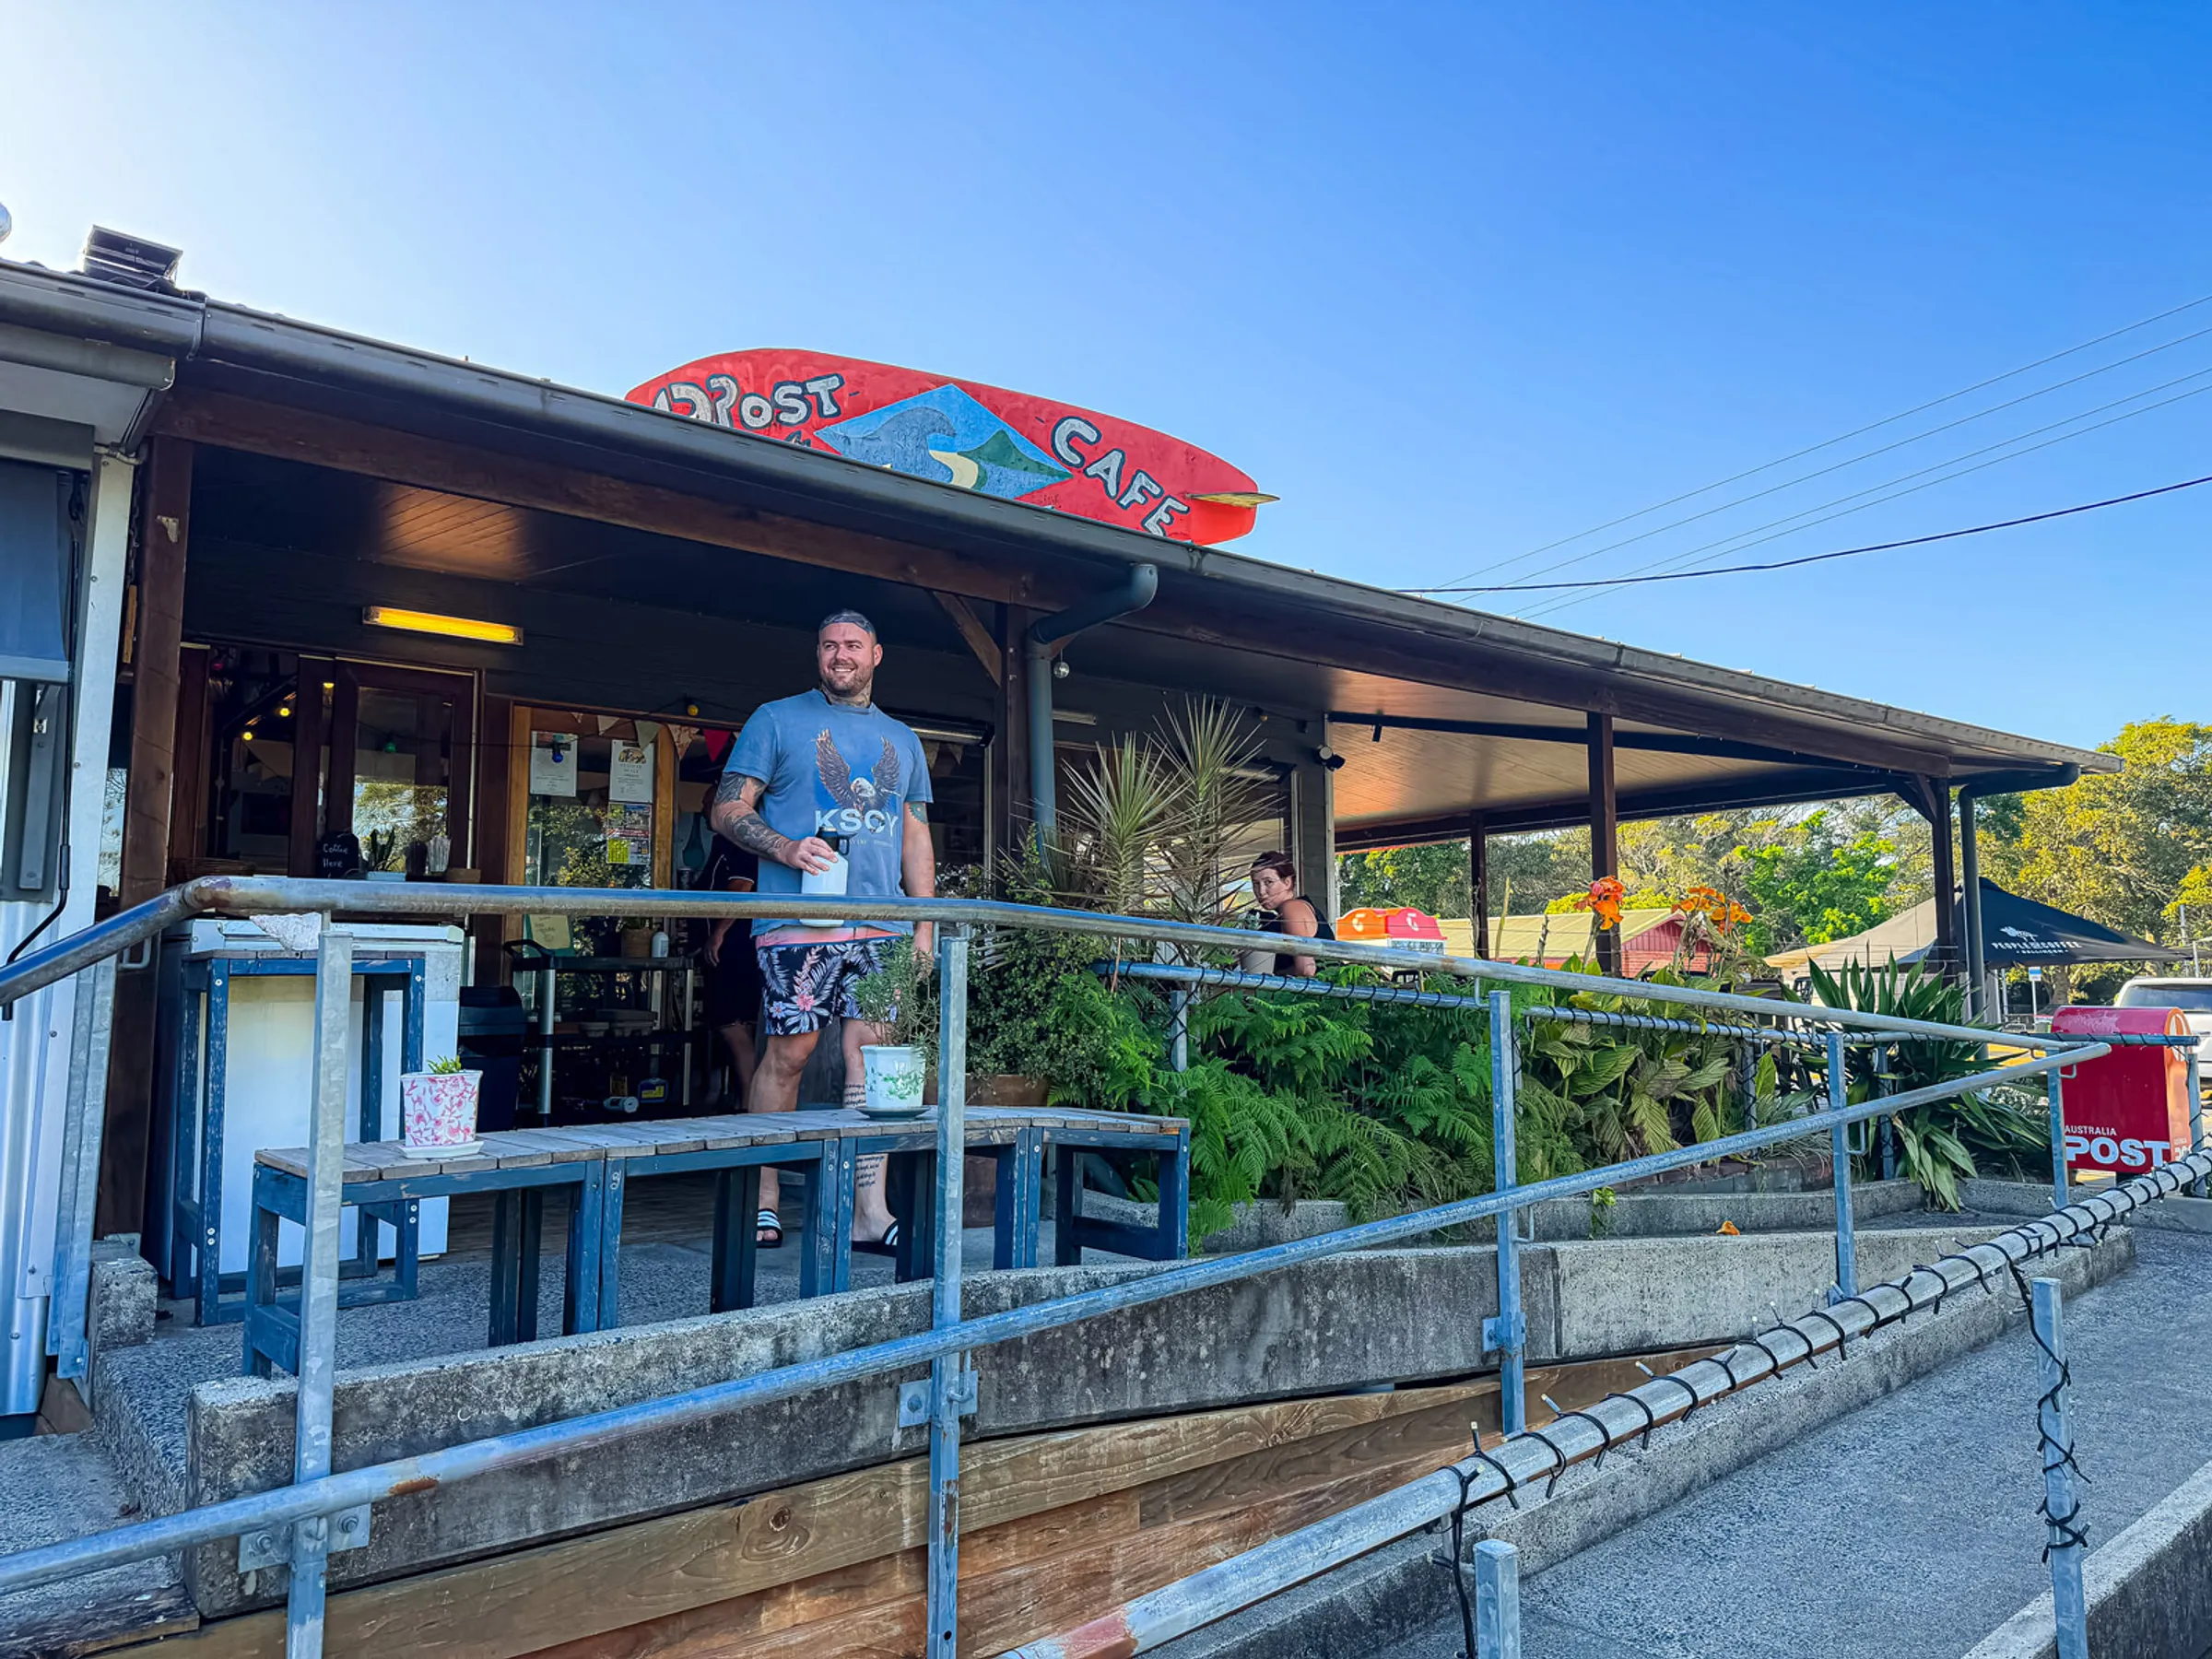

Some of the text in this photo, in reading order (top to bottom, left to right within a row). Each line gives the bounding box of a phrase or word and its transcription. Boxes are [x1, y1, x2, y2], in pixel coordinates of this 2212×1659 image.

[1051, 416, 1191, 536] CAFE
[2064, 1124, 2117, 1136] AUSTRALIA
[2065, 1135, 2171, 1167] POST
